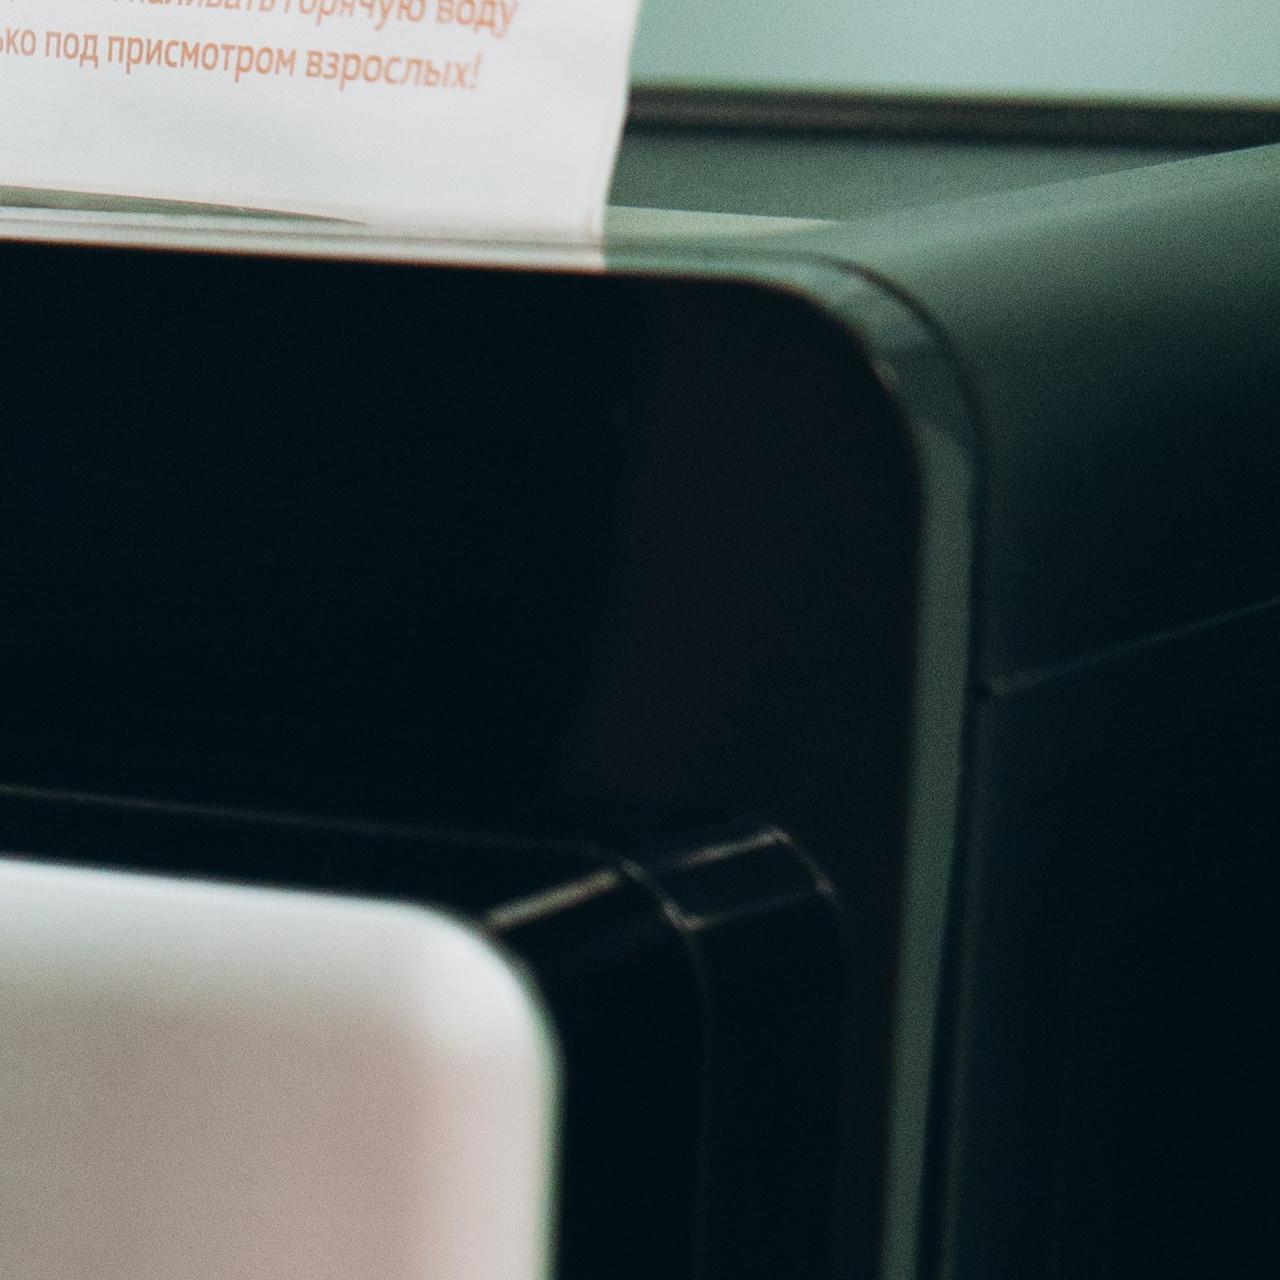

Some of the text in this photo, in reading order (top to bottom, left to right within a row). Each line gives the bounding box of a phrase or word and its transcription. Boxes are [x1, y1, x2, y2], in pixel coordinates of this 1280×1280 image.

[435, 0, 518, 39] воду
[44, 30, 99, 69] под
[108, 35, 297, 83] присмотром
[305, 49, 482, 91] взрослых!
